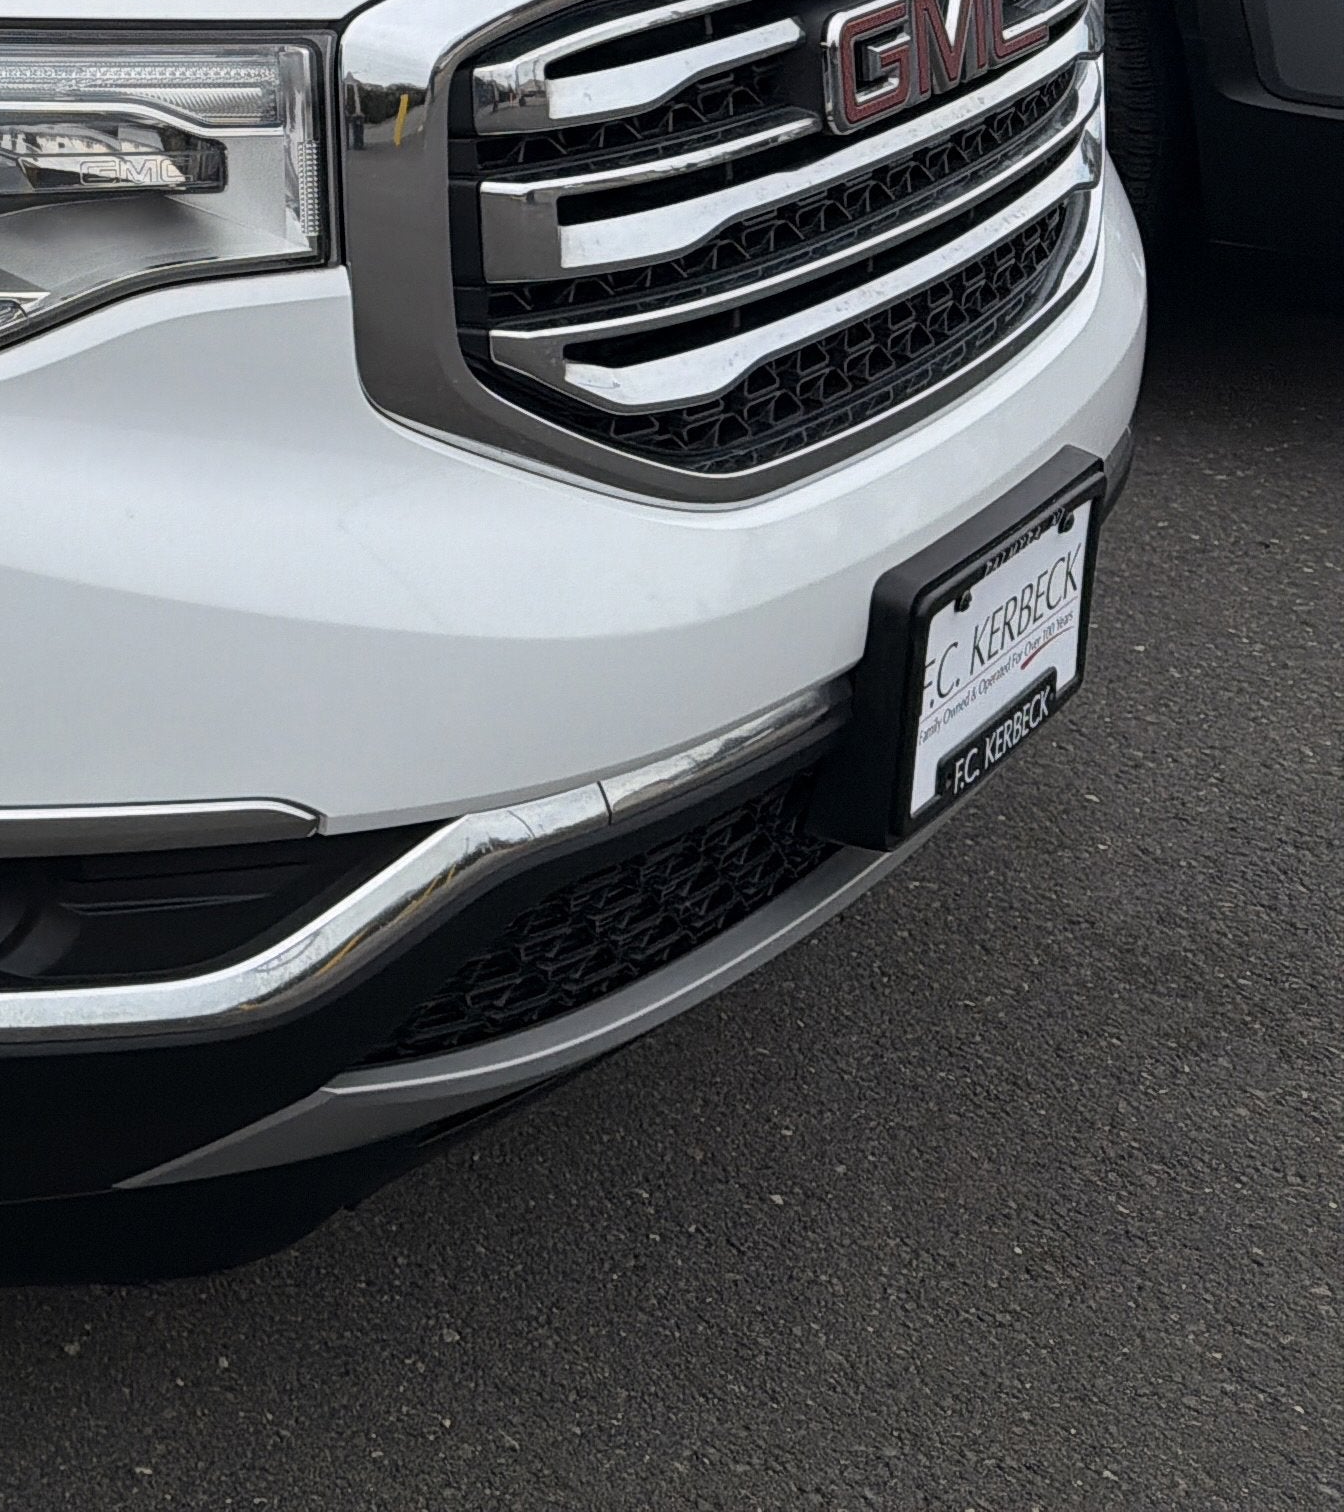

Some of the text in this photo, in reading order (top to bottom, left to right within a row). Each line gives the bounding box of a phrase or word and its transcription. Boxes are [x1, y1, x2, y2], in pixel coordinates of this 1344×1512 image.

[79, 156, 194, 186] GMC
[969, 542, 1082, 676] KERBECK
[918, 717, 943, 746] Family
[943, 692, 971, 725] Owned
[978, 656, 1012, 695] Operated
[1023, 636, 1042, 657] Over
[1041, 622, 1056, 641] 100
[1055, 610, 1074, 630] Years
[983, 685, 1051, 769] KERBECK
